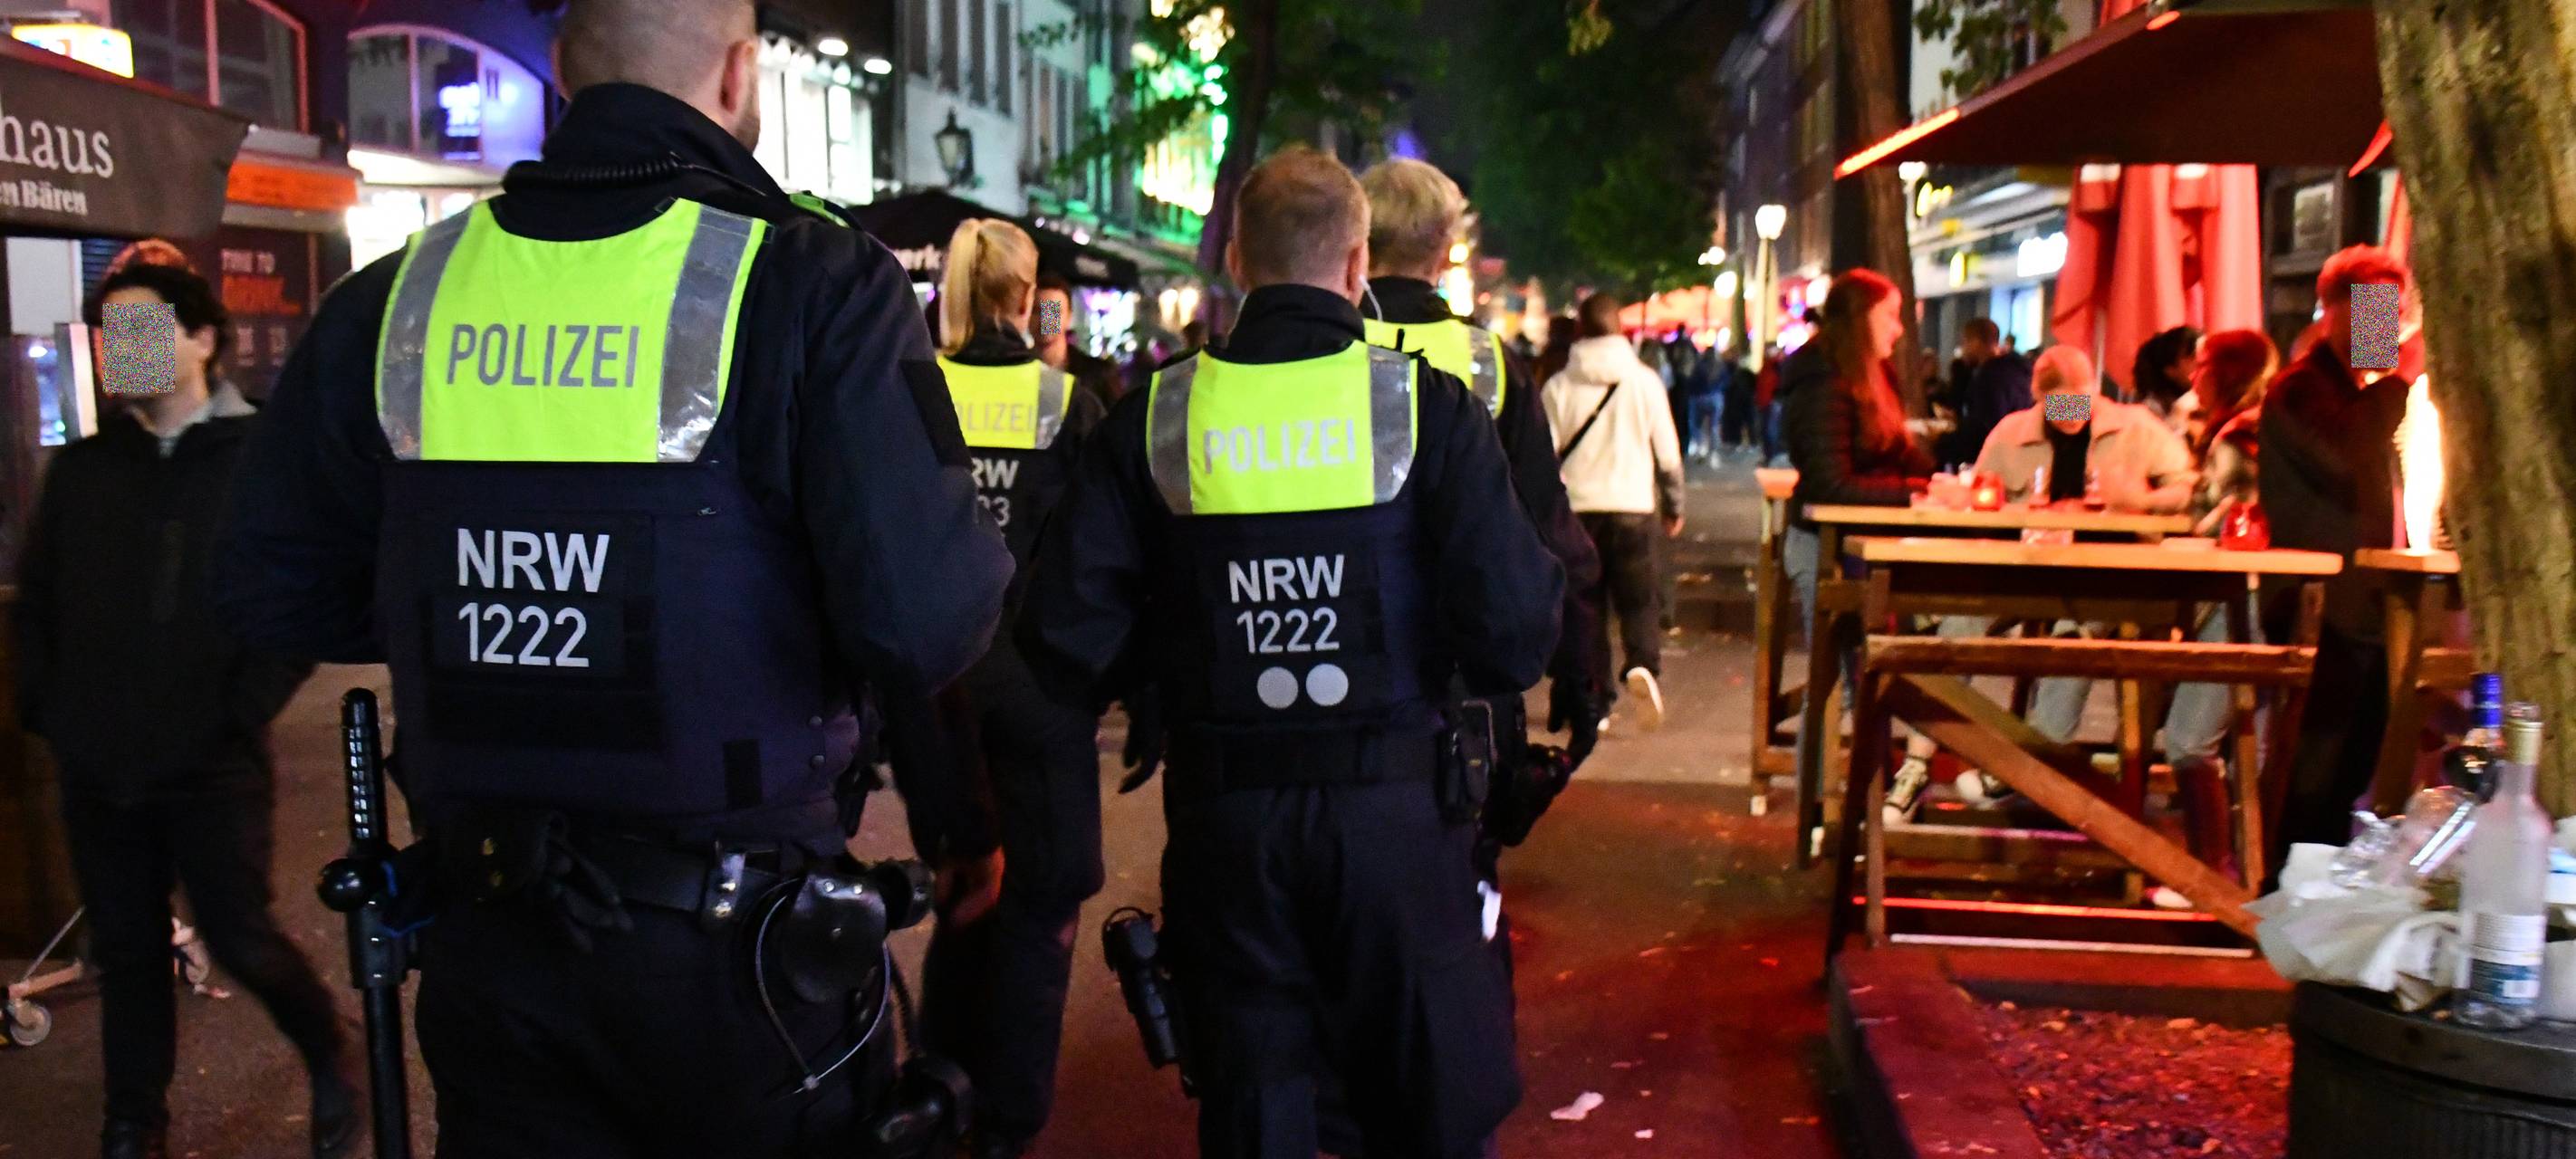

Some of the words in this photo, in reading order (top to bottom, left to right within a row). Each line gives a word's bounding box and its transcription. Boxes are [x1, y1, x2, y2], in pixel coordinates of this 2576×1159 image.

[21, 179, 88, 216] Bären
[894, 244, 940, 270] erk
[447, 323, 639, 388] POLIZEI
[955, 401, 1035, 433] LIZEI
[1204, 418, 1357, 474] POLIZEI
[971, 456, 1019, 490] RW
[457, 528, 610, 593] NRW
[1228, 554, 1345, 604] NRW
[458, 601, 591, 667] 1222
[1236, 607, 1341, 655] 1222
